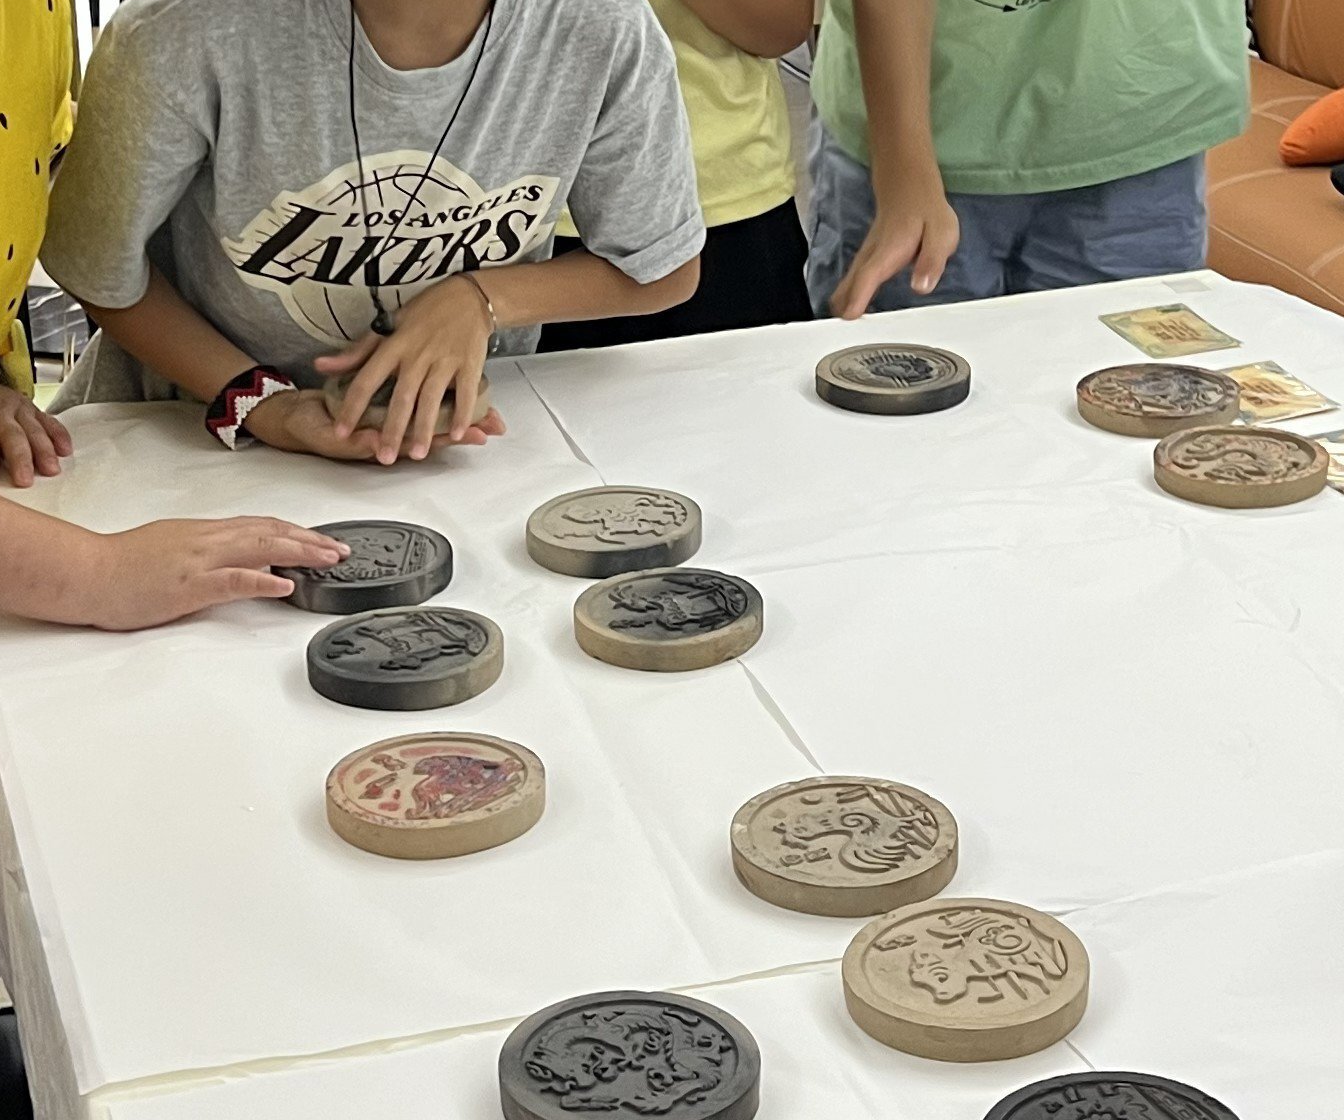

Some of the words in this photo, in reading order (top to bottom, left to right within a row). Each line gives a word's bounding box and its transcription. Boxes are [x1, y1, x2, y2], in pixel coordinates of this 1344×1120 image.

[342, 210, 404, 228] LOS
[406, 185, 543, 228] ANGELES
[234, 202, 538, 287] LAKERS
